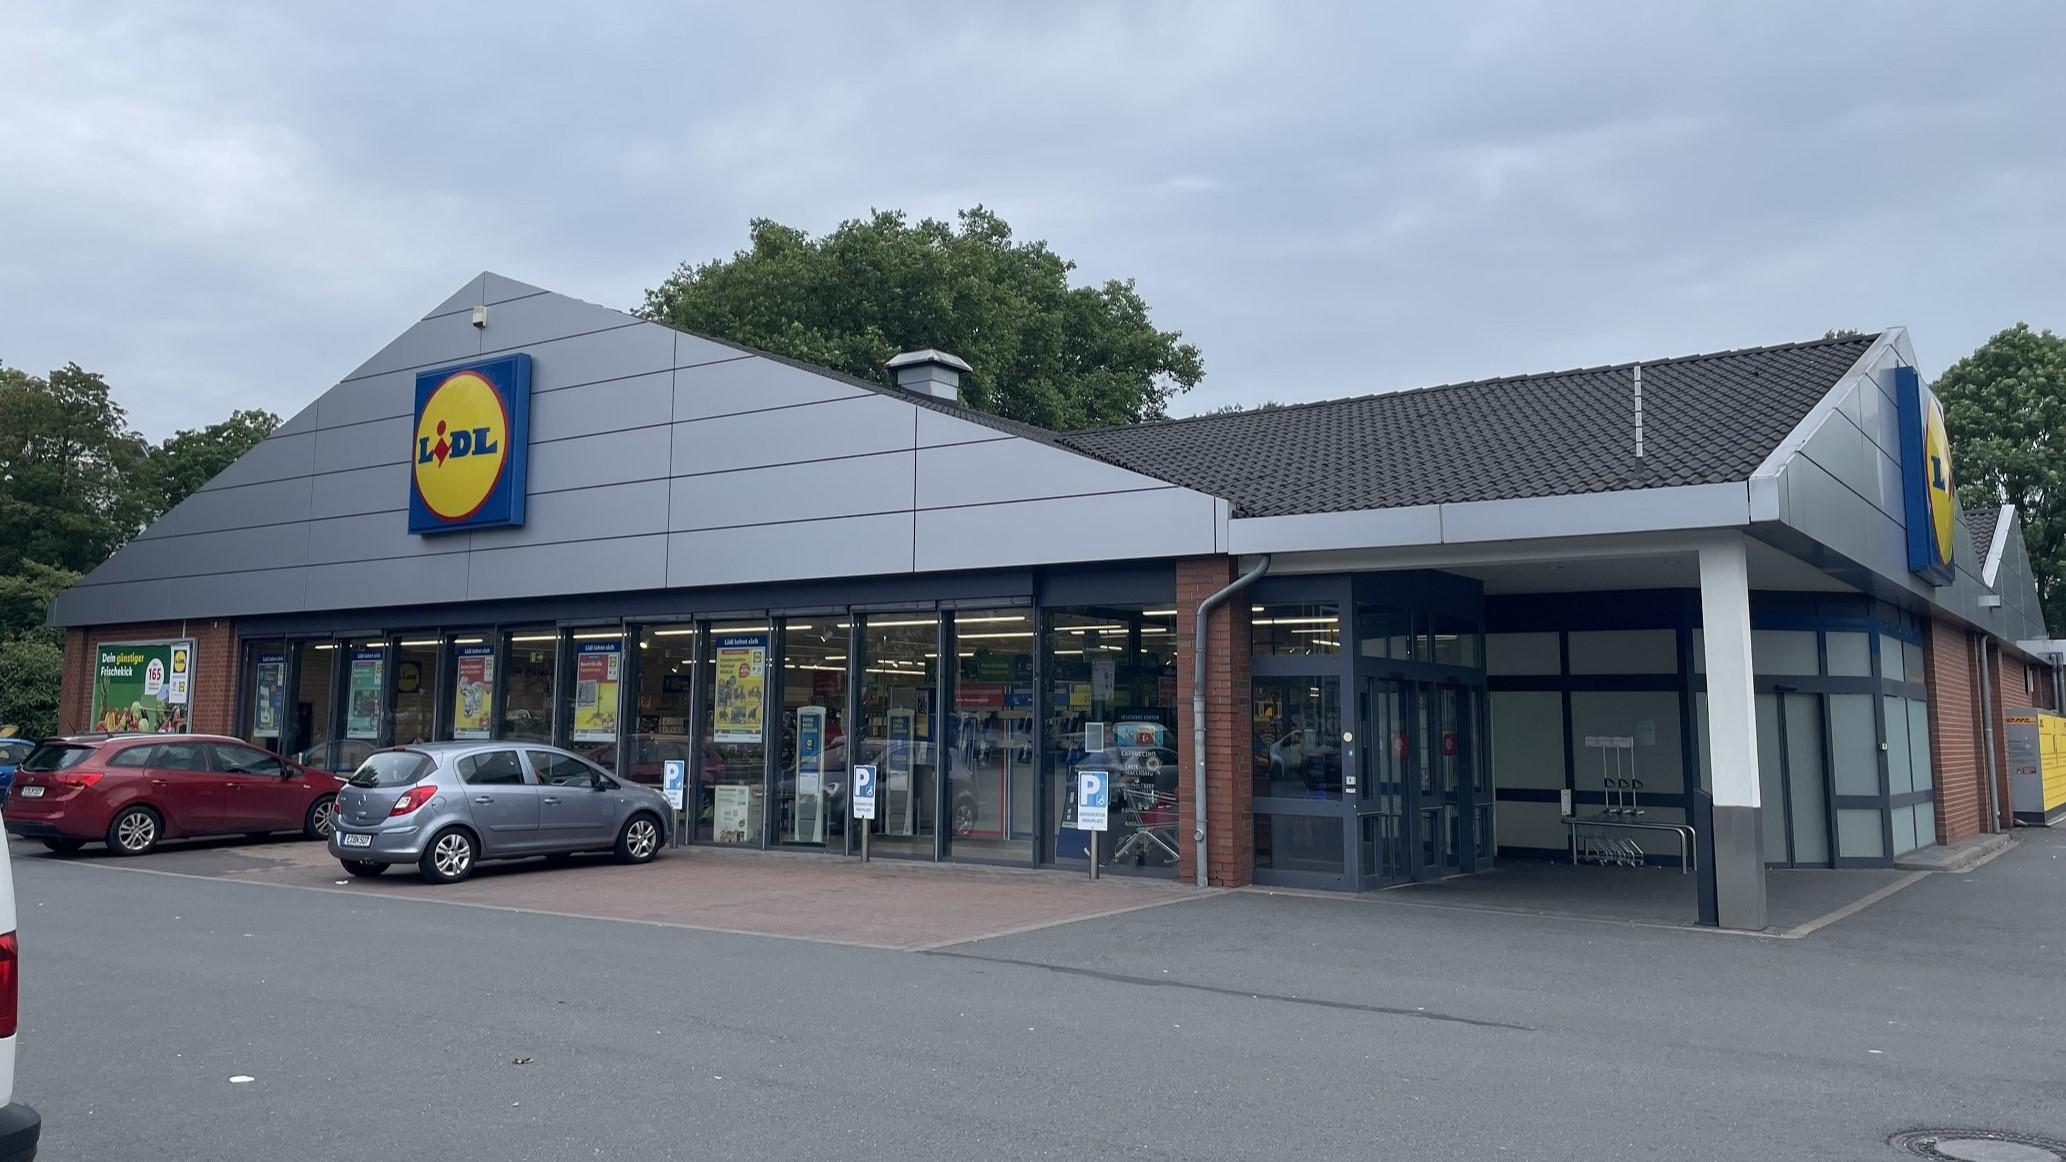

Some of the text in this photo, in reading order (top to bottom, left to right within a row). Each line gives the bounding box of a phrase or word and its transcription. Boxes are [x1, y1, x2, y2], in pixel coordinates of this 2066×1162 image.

[102, 652, 144, 665] Dein günstiger
[100, 665, 133, 677] Frischekick
[149, 668, 161, 681] 165
[665, 763, 680, 789] P
[855, 768, 870, 796] P
[1081, 774, 1101, 806] P
